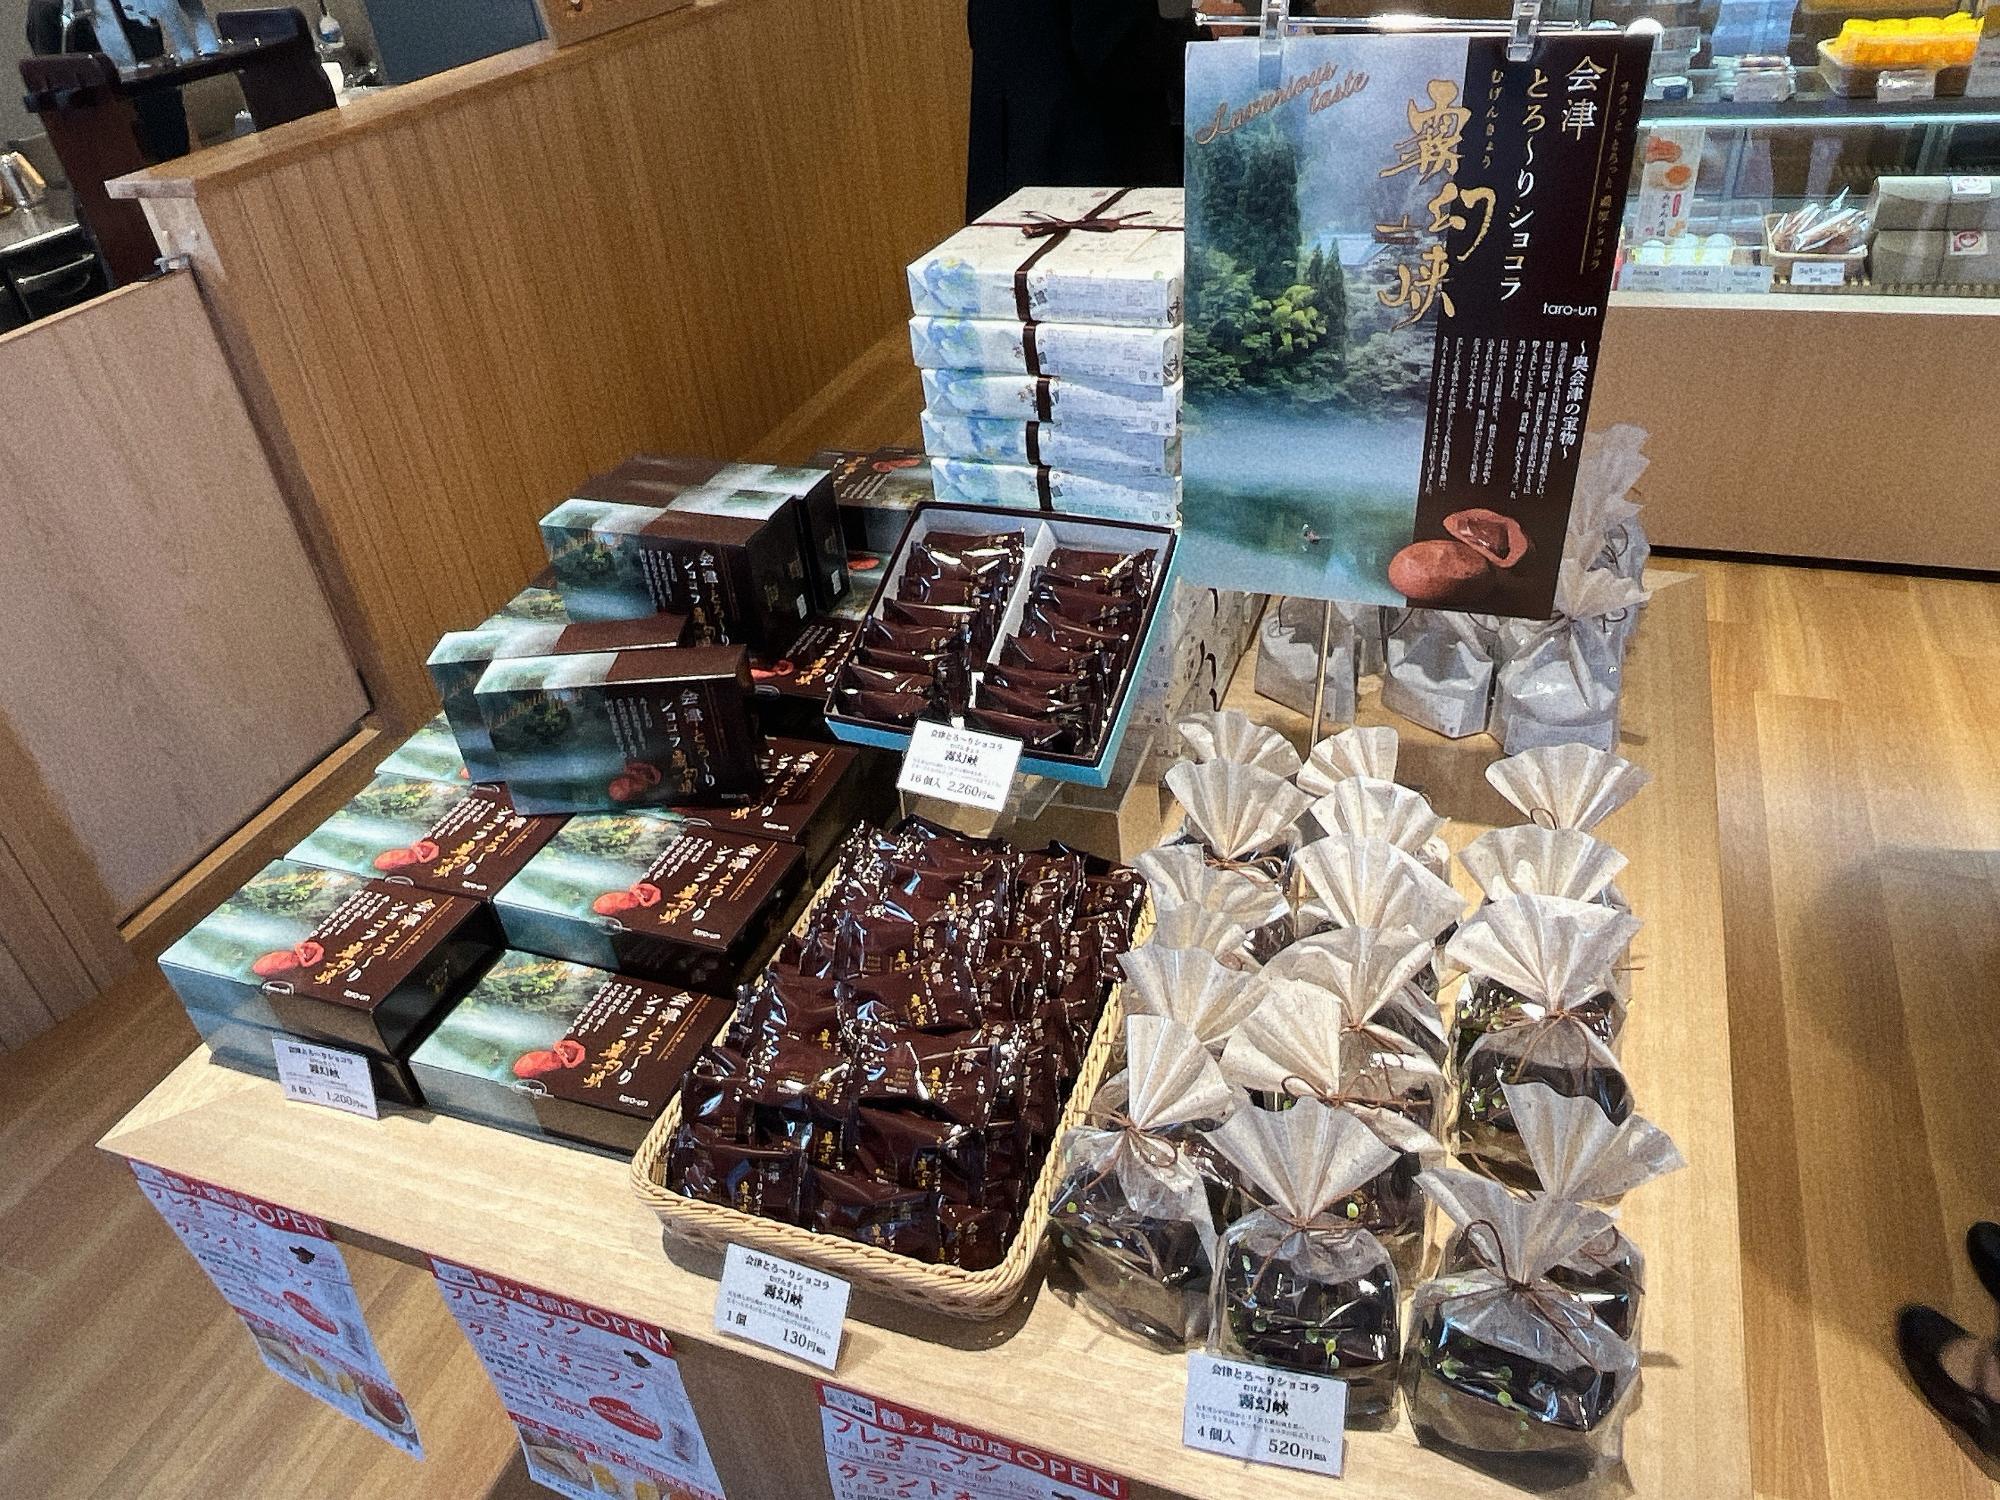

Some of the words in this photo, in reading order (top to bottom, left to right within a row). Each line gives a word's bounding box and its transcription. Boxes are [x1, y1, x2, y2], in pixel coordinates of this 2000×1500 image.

[1309, 70, 1369, 115] taste
[1561, 56, 1606, 142] 会津
[1542, 302, 1598, 317] taro-un
